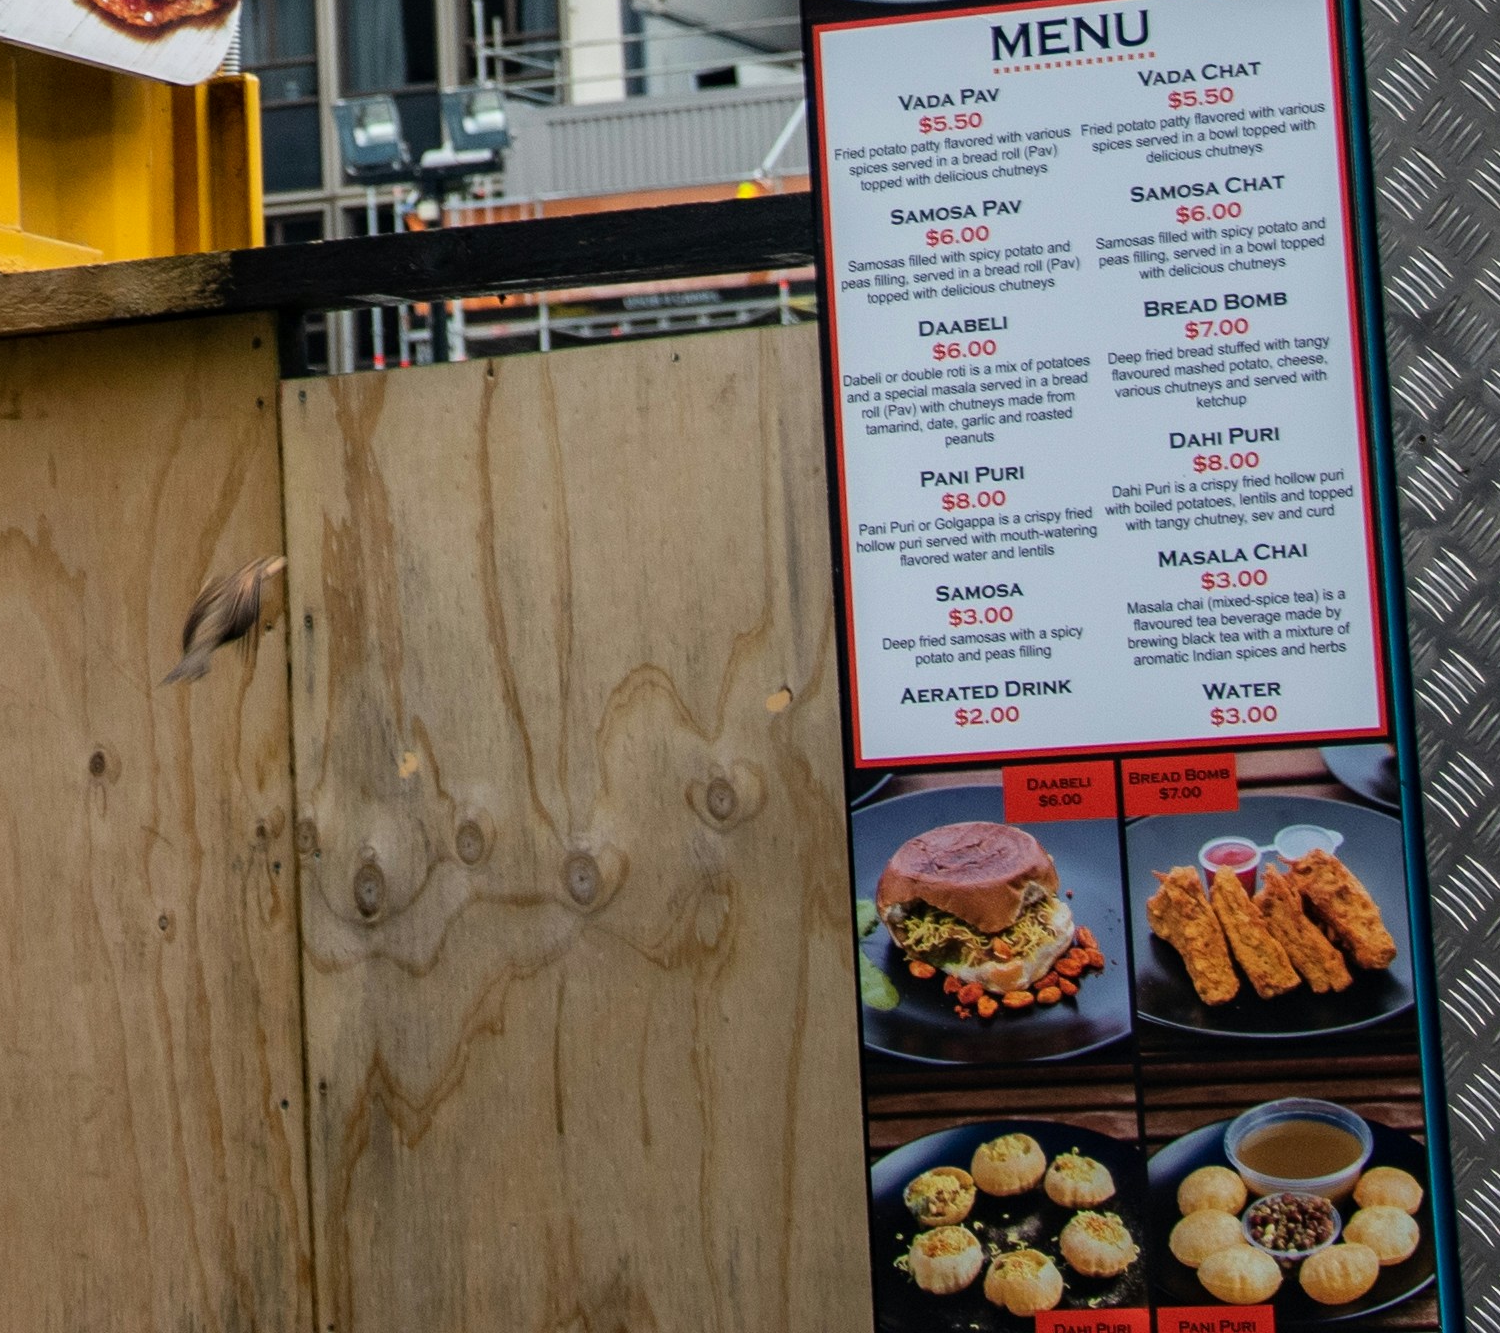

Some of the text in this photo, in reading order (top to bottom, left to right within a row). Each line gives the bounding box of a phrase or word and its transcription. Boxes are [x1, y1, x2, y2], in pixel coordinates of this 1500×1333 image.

[990, 9, 1150, 62] MENU
[1137, 61, 1262, 87] VADA CHAT
[897, 87, 1000, 111] VADA PAV
[1168, 86, 1234, 110] $5.50
[919, 112, 983, 134] $5.50
[834, 127, 1072, 161] Fried potato patty flavored with various
[1146, 143, 1264, 164] delicious chutneys
[849, 143, 1058, 177] spices served in a bread roll (Pav)
[860, 163, 1049, 193] topped with delicious chutneys
[1130, 174, 1286, 204] SAMOSA CHAT
[890, 199, 1023, 226] SAMOSA PAV
[1175, 201, 1242, 225] $6.00
[925, 225, 990, 248] $6.00
[1143, 291, 1289, 318] BREAD BOMB
[918, 315, 1009, 338] DAABELI
[1184, 317, 1249, 340] $7.00
[932, 339, 997, 362] $6.00
[1107, 336, 1330, 365] Deep fried bread stuffed with tangy
[843, 356, 1091, 388] Dabeli or double roti is a mix of potatoes
[1111, 354, 1328, 382] flavoured mashed potato, cheese,
[861, 391, 1076, 420] roll (Pav) with chutneys made from
[1196, 394, 1248, 408] ketchup
[865, 406, 1073, 436] tamarind, date, garlic and roasted
[944, 431, 995, 448] peanuts
[1169, 426, 1281, 450] DAHI PURI
[1192, 451, 1260, 474] $8.00
[920, 465, 1025, 488] PANI PURI
[1112, 468, 1345, 499] Dahi Puri is a crispy fried hollow puri
[941, 489, 1006, 512] $8.00
[856, 524, 1098, 553] hollow puri served with mouth-watering
[899, 544, 1056, 567] flavored water and lentils
[1157, 543, 1309, 568] MASALA CHAI
[1200, 568, 1268, 591] $3.00
[935, 582, 1025, 603] SAMOSA
[948, 605, 1014, 628] $3.00
[1133, 641, 1348, 667] aromatic Indian spices and herbs
[900, 679, 1073, 705] AERATED DRINK
[1201, 681, 1282, 701] WATER
[954, 705, 1020, 727] $2.00
[1210, 705, 1278, 727] $3.00
[1038, 793, 1082, 807] $6.00
[1159, 786, 1202, 800] $7.00
